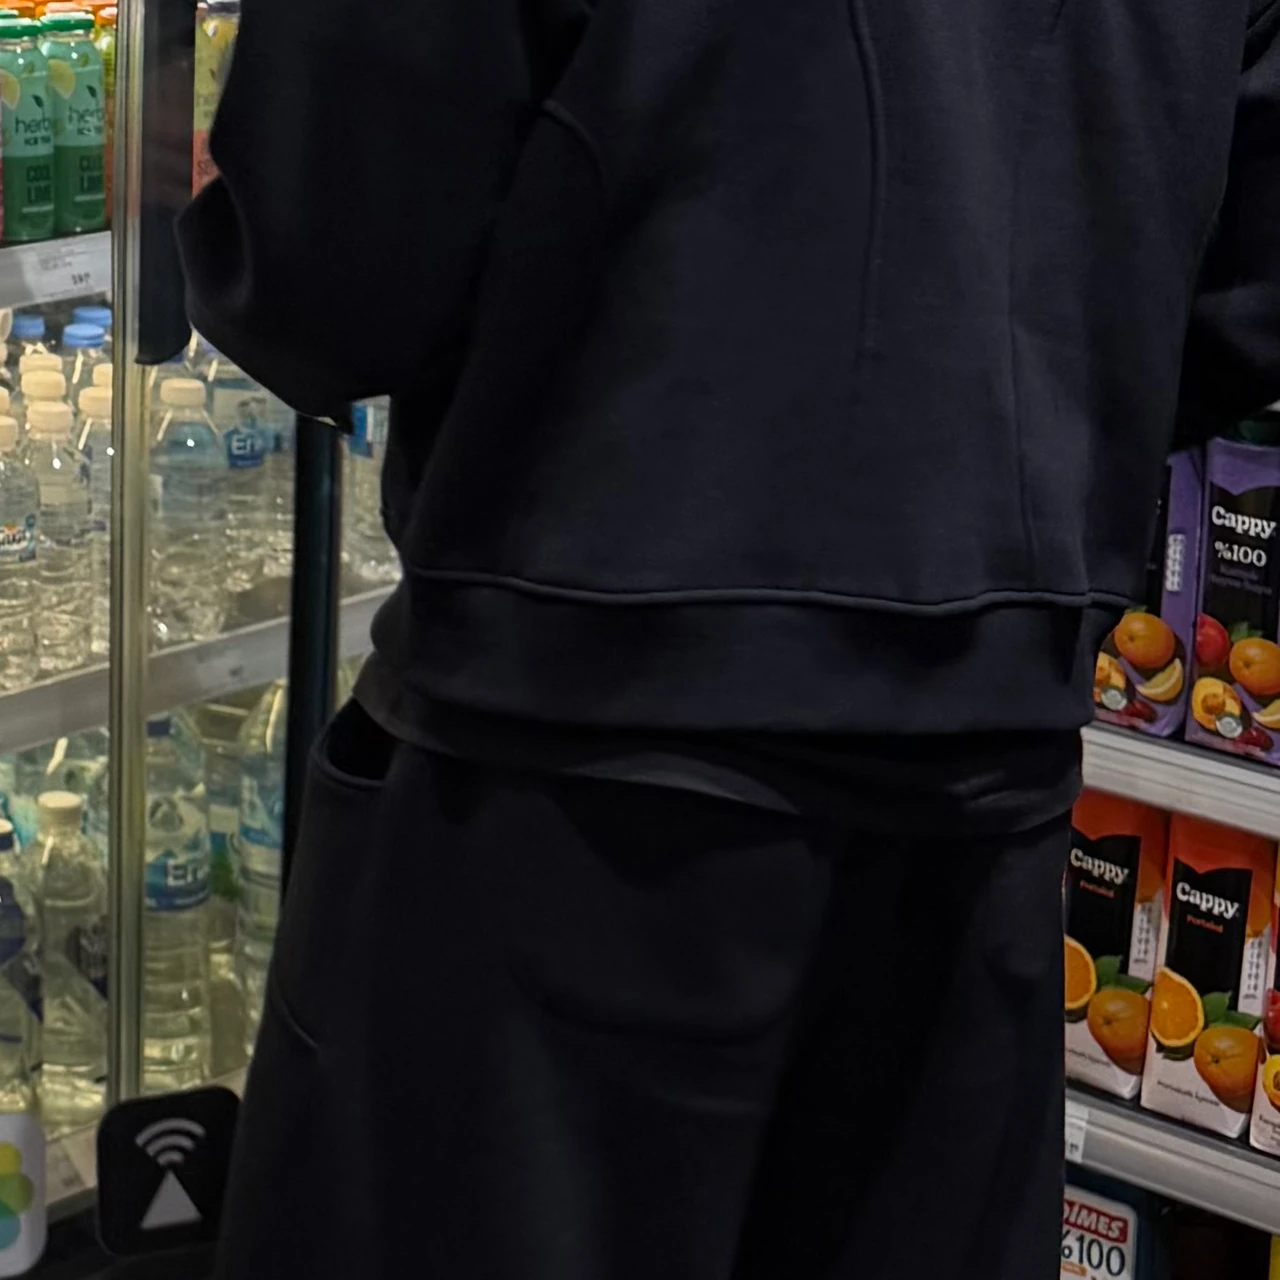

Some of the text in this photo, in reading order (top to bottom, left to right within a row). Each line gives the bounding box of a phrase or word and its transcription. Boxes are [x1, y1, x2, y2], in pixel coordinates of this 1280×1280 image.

[1211, 506, 1277, 540] Cappy
[1070, 847, 1130, 885] Cappy
[1176, 881, 1239, 919] Cappy
